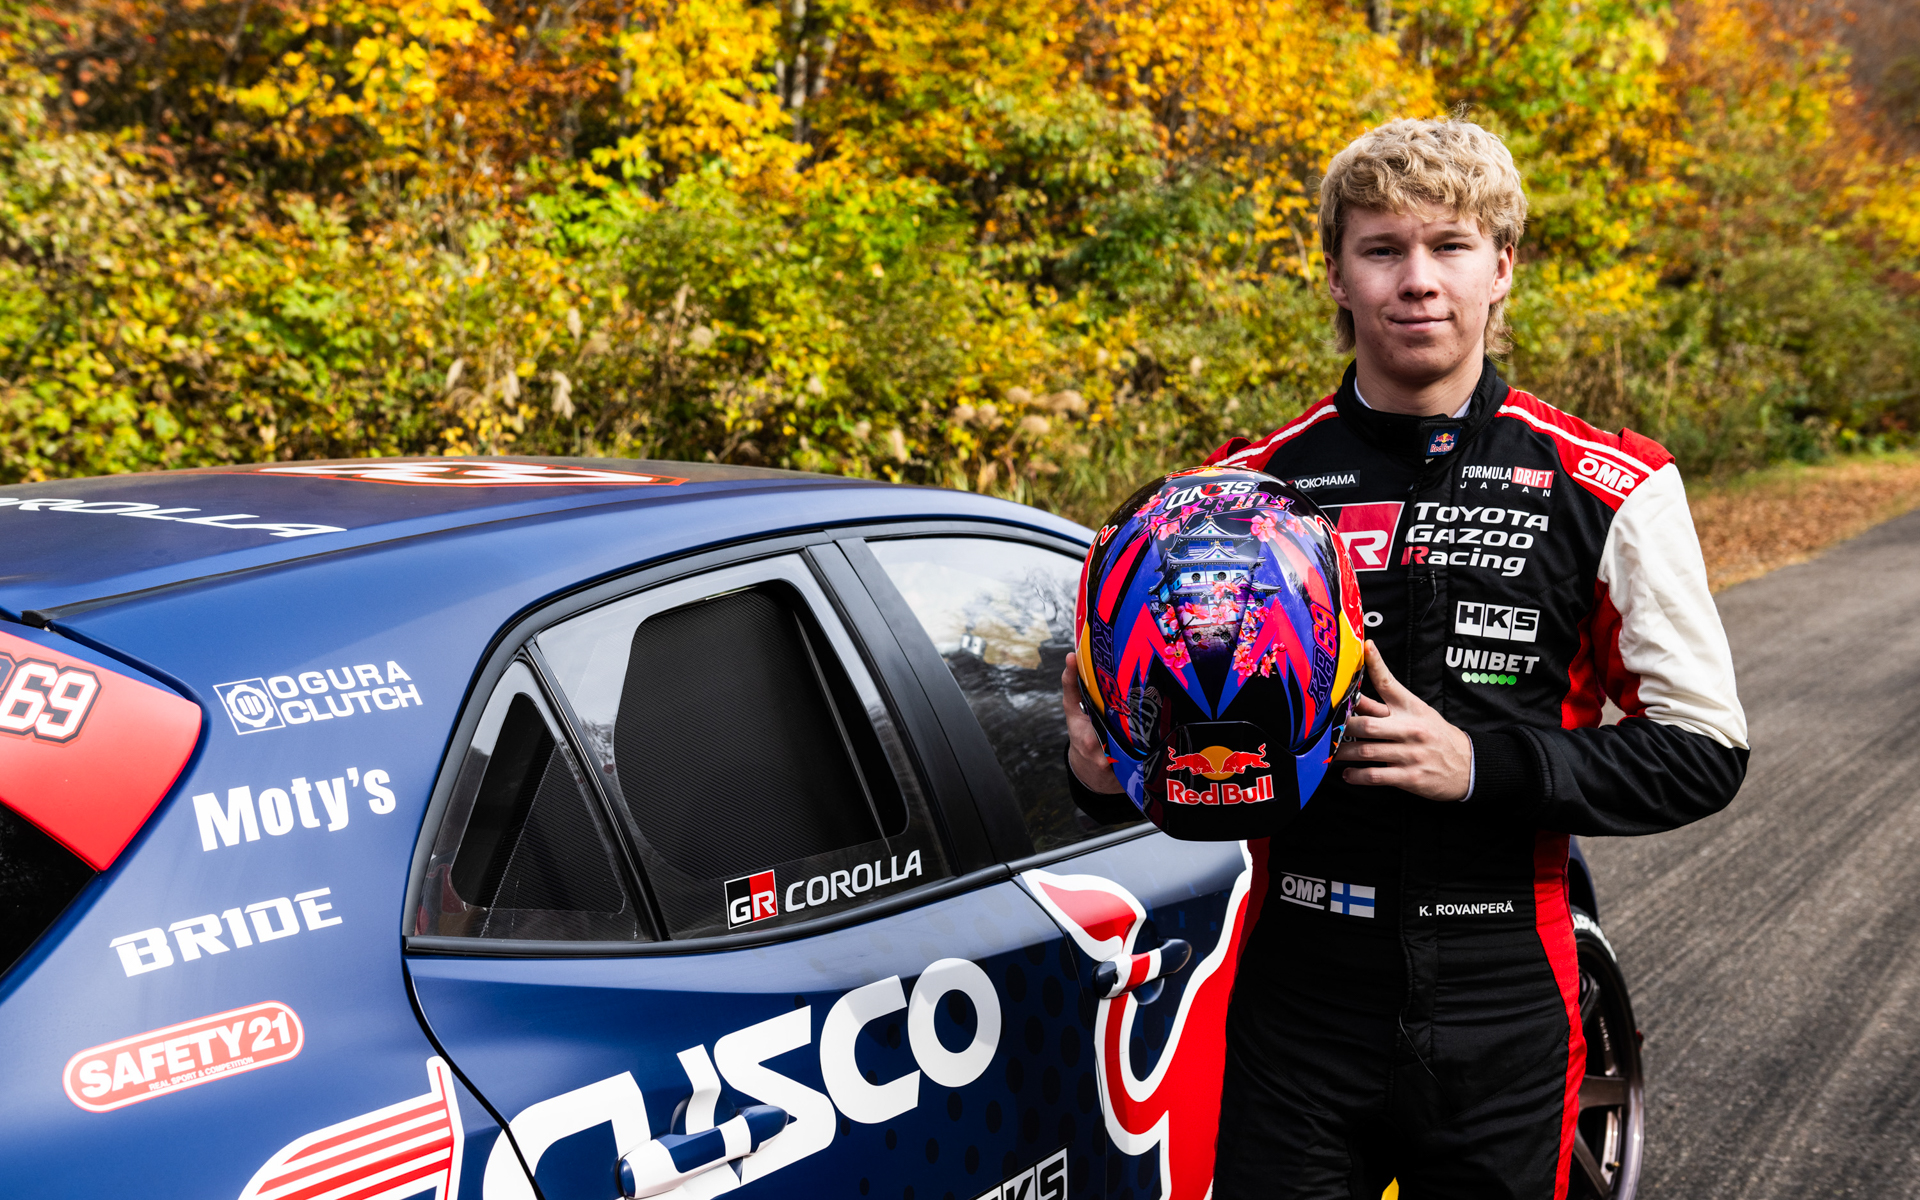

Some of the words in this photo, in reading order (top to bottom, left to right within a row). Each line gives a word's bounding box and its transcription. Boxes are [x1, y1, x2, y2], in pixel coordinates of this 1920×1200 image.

[1294, 474, 1356, 490] YOKOHAMA
[1460, 481, 1551, 498] JAPAN
[1461, 465, 1512, 481] FORMULA
[1514, 467, 1553, 488] DRIFT
[1577, 457, 1636, 492] OMP
[1414, 502, 1550, 532] TOYOTA
[1339, 529, 1389, 566] R
[1405, 524, 1534, 549] GAZOO
[1400, 545, 1527, 577] Racing
[1457, 603, 1539, 633] HKS
[1445, 645, 1540, 675] UNIBET
[267, 660, 412, 699] OGURA
[0, 657, 99, 739] 69
[280, 684, 424, 725] CLUTCH
[1166, 778, 1220, 806] Red
[1221, 773, 1275, 806] Bull
[192, 766, 397, 852] Moty's
[729, 889, 776, 925] GR
[785, 849, 923, 913] COROLLA
[1281, 875, 1326, 904] OMP
[1419, 905, 1433, 917] K.
[1435, 900, 1514, 916] ROVANPERÄ
[109, 887, 343, 978] BRIDE
[148, 1079, 171, 1091] REAL
[170, 1071, 197, 1085] SPORT
[204, 1056, 255, 1075] COMPETITION
